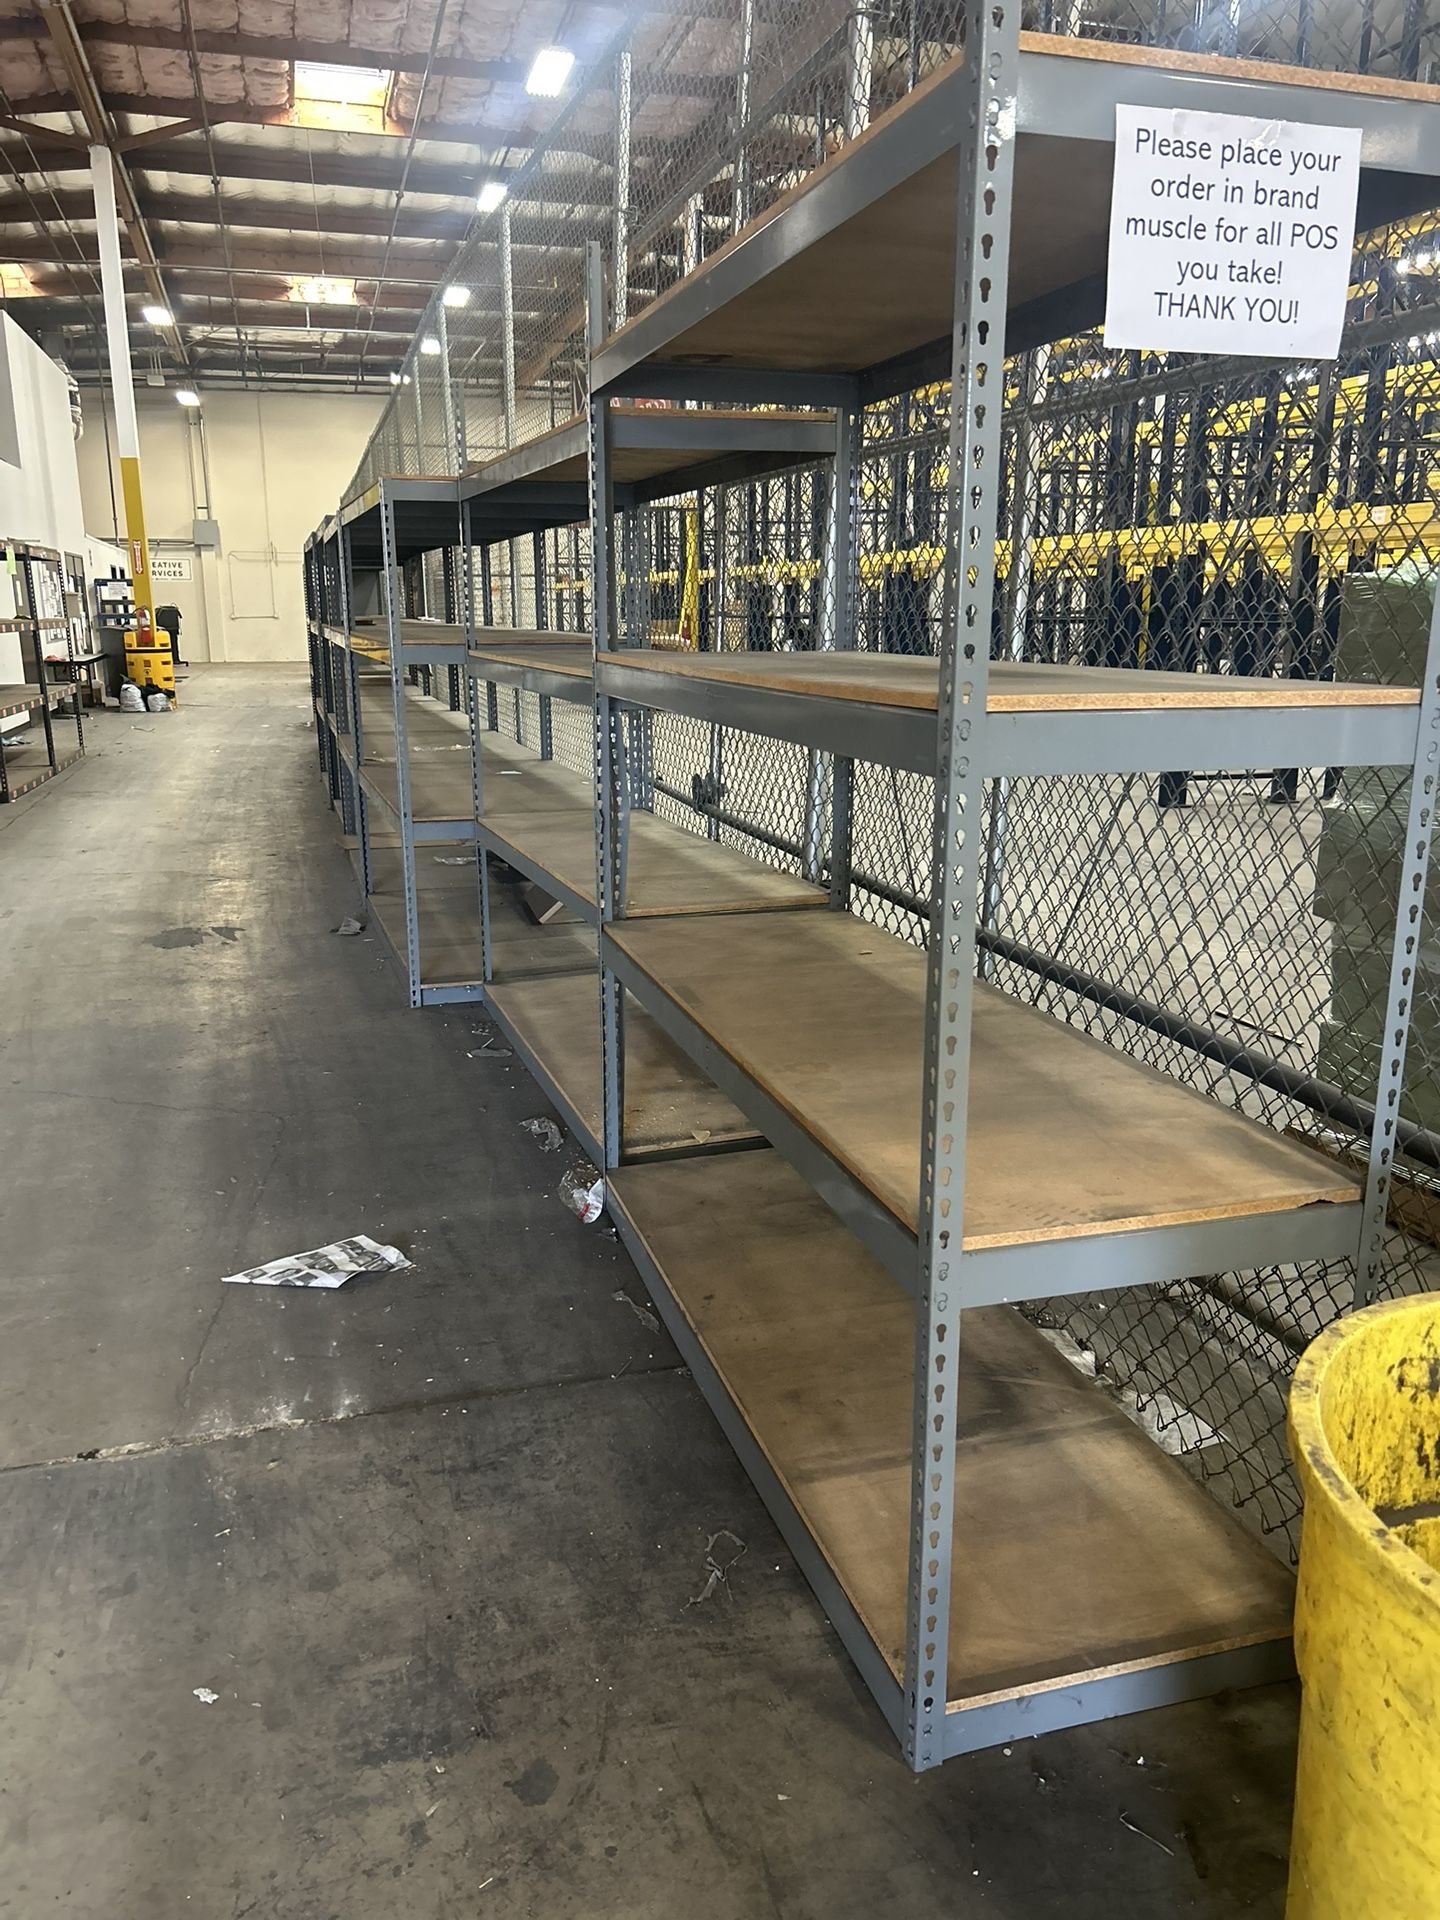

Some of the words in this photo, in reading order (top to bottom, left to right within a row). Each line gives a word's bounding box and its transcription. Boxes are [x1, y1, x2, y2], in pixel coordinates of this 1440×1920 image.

[1135, 127, 1212, 161] Please
[1220, 137, 1282, 170] place
[1289, 150, 1342, 176] your
[1150, 173, 1216, 201] order
[1223, 177, 1244, 204] in
[1253, 179, 1320, 210] brand
[1125, 214, 1207, 241] muscle
[1215, 216, 1249, 244] for
[1255, 220, 1282, 246] all
[1290, 222, 1338, 250] POS
[1176, 260, 1219, 286] you
[1227, 258, 1283, 285] take!
[1153, 291, 1236, 321] THANK
[1244, 297, 1300, 324] YOU!
